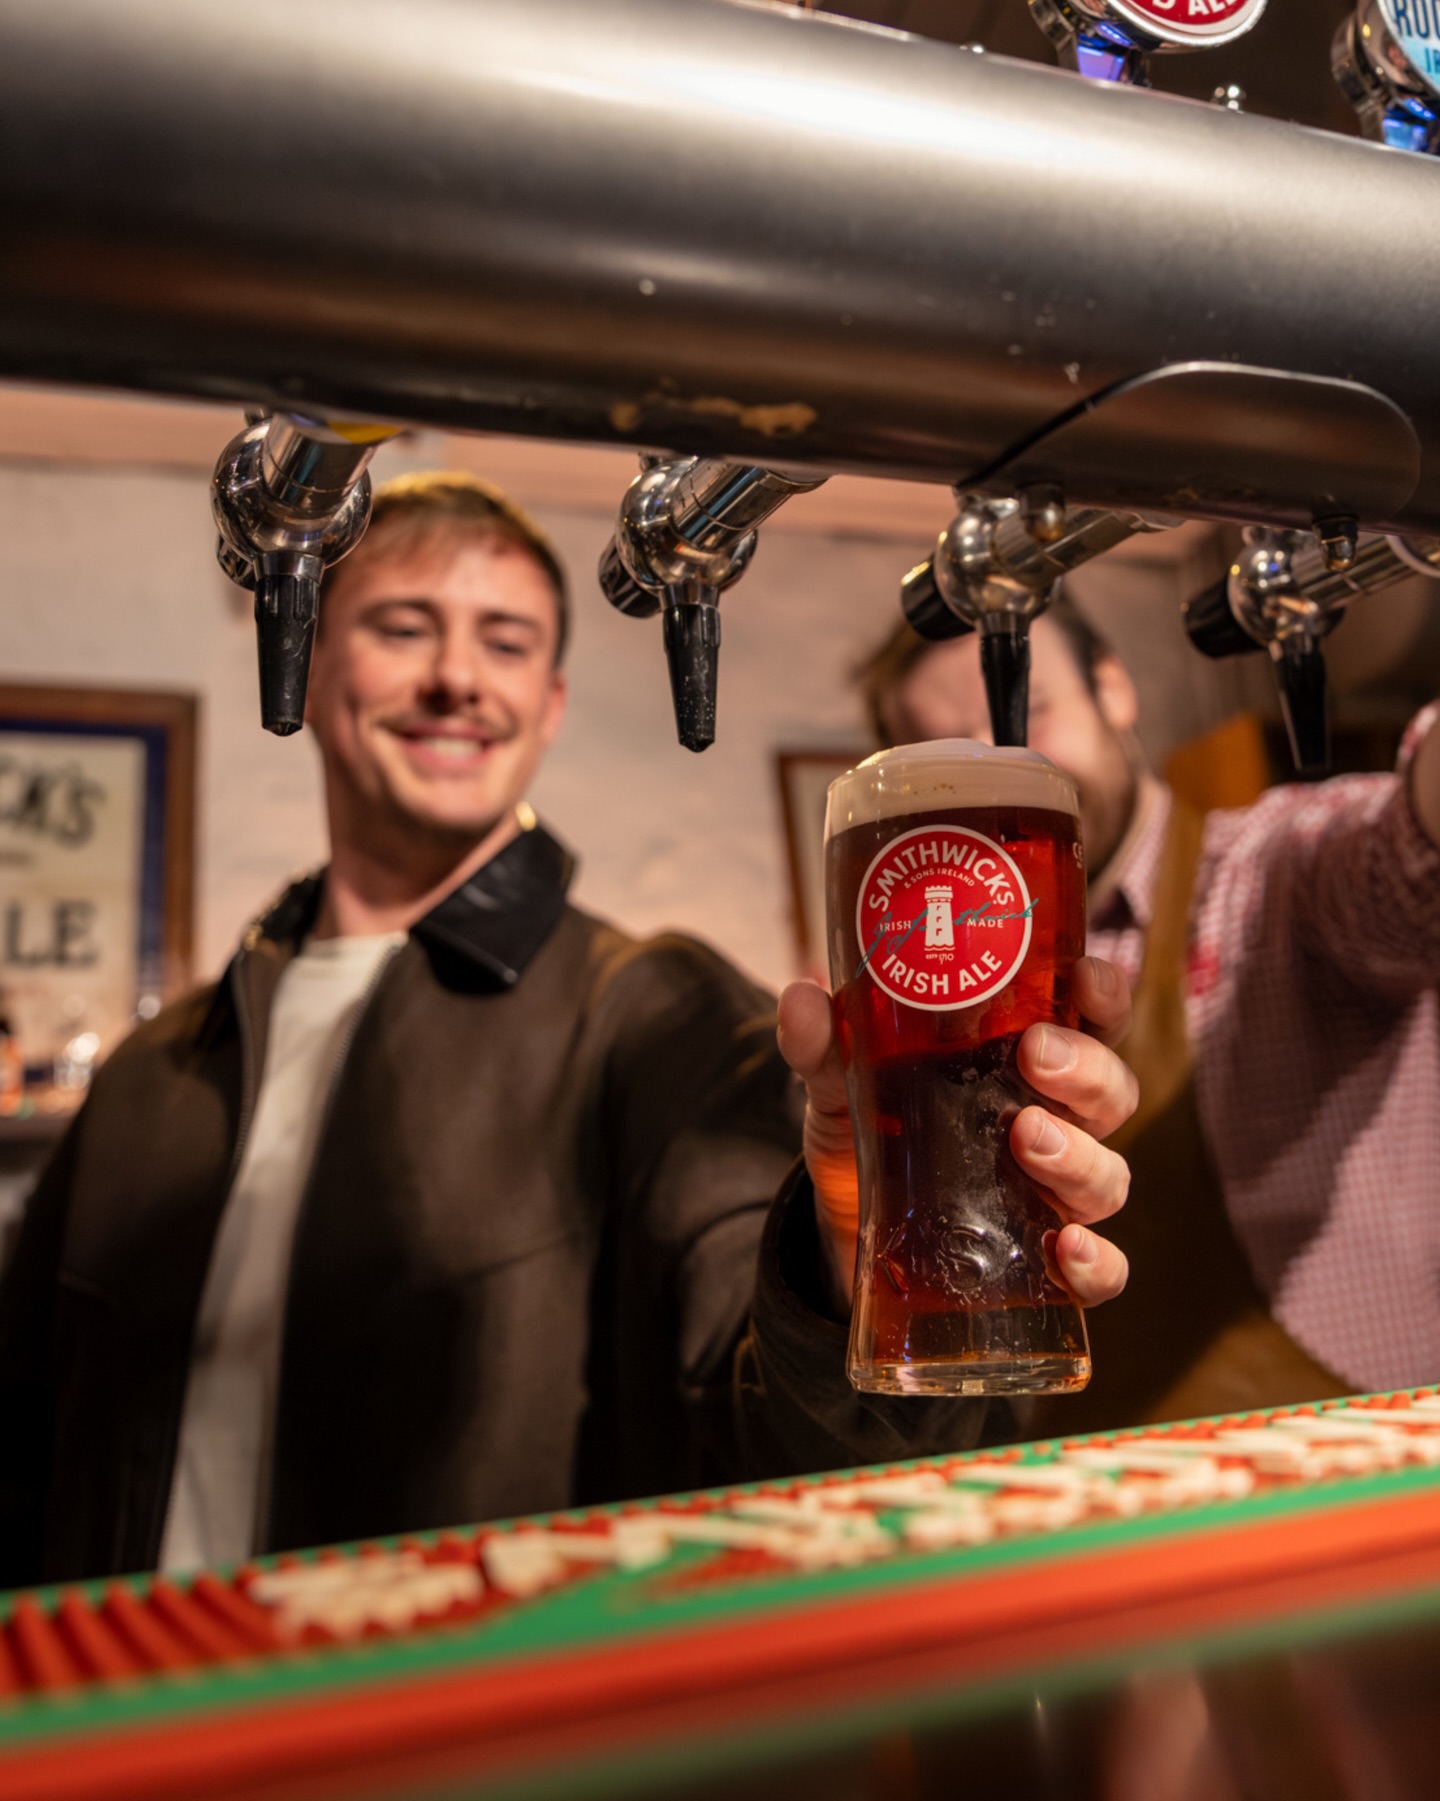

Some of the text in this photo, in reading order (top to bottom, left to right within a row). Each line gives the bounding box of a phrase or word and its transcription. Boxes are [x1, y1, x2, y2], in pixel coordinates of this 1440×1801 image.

[1188, 0, 1237, 16] AL
[911, 868, 935, 883] SONS
[937, 868, 975, 887] IRELAND
[879, 920, 912, 932] IRISH
[967, 918, 1004, 929] MADE
[881, 950, 1003, 996] IRISH ALE
